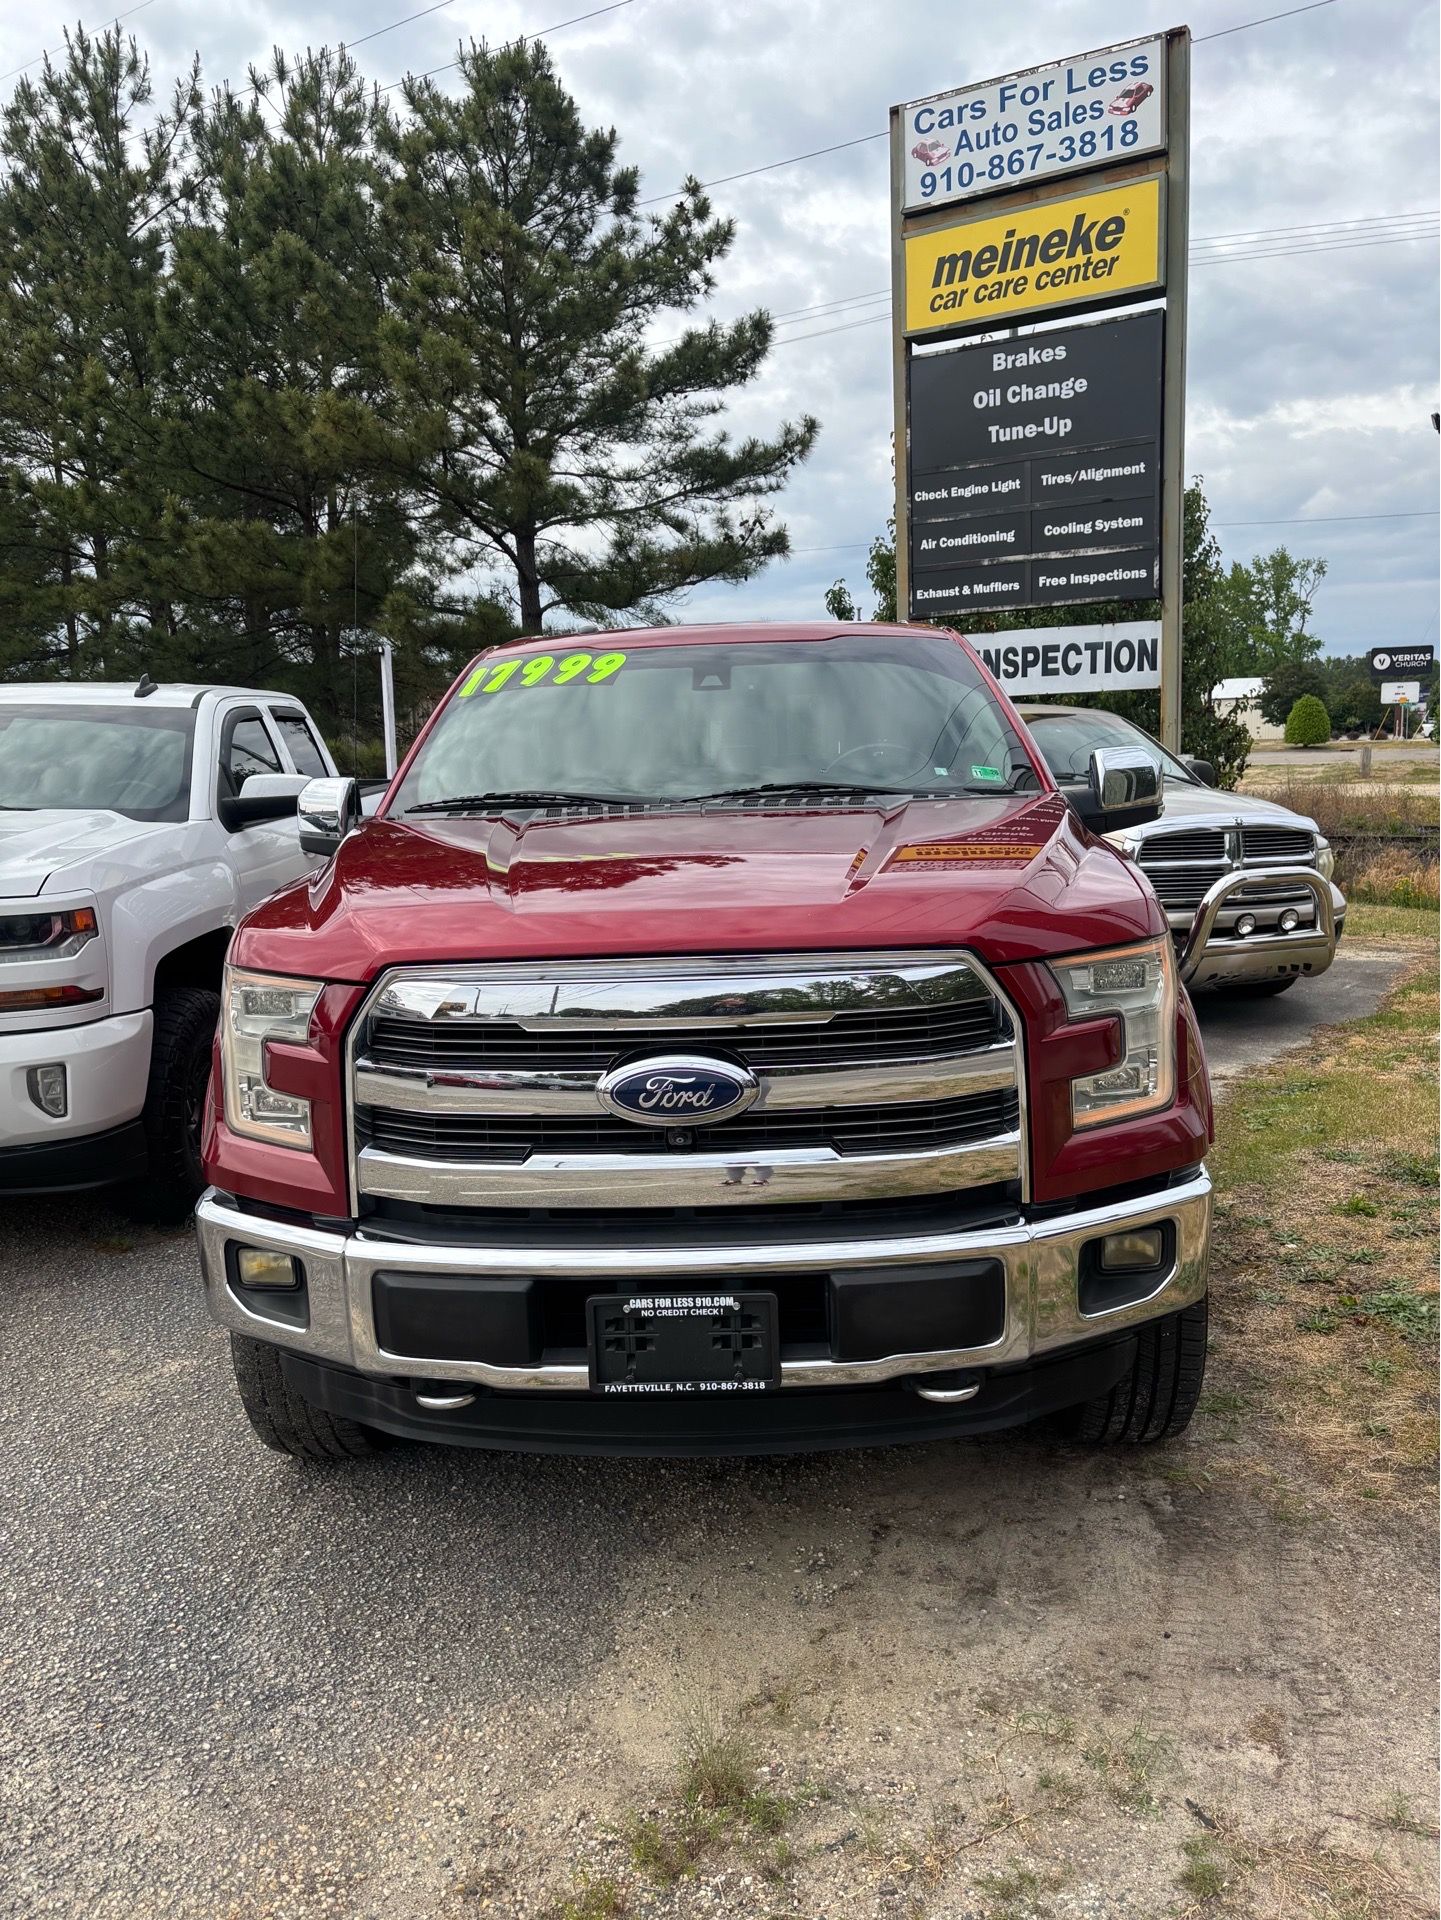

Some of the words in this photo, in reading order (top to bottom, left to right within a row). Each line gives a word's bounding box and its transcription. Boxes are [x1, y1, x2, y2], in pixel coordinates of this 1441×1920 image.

[914, 99, 986, 135] Cars
[1000, 79, 1054, 112] For
[1067, 55, 1149, 95] Less
[954, 123, 1018, 156] Auto
[1028, 100, 1104, 136] Sales
[920, 120, 1138, 197] 910-867-3818
[931, 212, 1126, 288] meineke
[929, 288, 968, 312] car
[974, 275, 1027, 304] care
[1035, 254, 1120, 295] center
[992, 345, 1067, 371] Brakes
[973, 389, 1000, 409] Oil
[1007, 377, 1088, 404] Change
[988, 416, 1072, 443] Tune-Up
[1041, 461, 1146, 486] Tires/Alignment
[914, 488, 948, 502] Check
[951, 483, 989, 498] Engine
[992, 479, 1021, 494] Light
[1044, 520, 1092, 537] Cooling
[1095, 516, 1143, 532] System
[920, 539, 937, 550] Air
[939, 530, 1015, 548] Conditioning
[916, 586, 959, 600] Exhaust
[962, 585, 971, 595] &
[973, 581, 1020, 594] Mufflers
[1038, 575, 1067, 588] Free
[1070, 568, 1147, 585] Inspections
[976, 638, 1158, 679] NSPECTION
[1391, 653, 1431, 662] VERITAS
[1395, 660, 1427, 668] CHURCH
[458, 653, 627, 698] 17999
[638, 1076, 716, 1109] Ford
[629, 1298, 653, 1309] CARS
[655, 1297, 672, 1308] FOR
[673, 1297, 694, 1308] LESS
[695, 1296, 734, 1307] 910.COM
[641, 1309, 654, 1317] NO
[656, 1308, 688, 1316] CREDIT
[605, 1384, 674, 1393] FAYETTEVILLE,
[676, 1383, 695, 1391] N.C.
[700, 1381, 766, 1391] 910-867-3818
